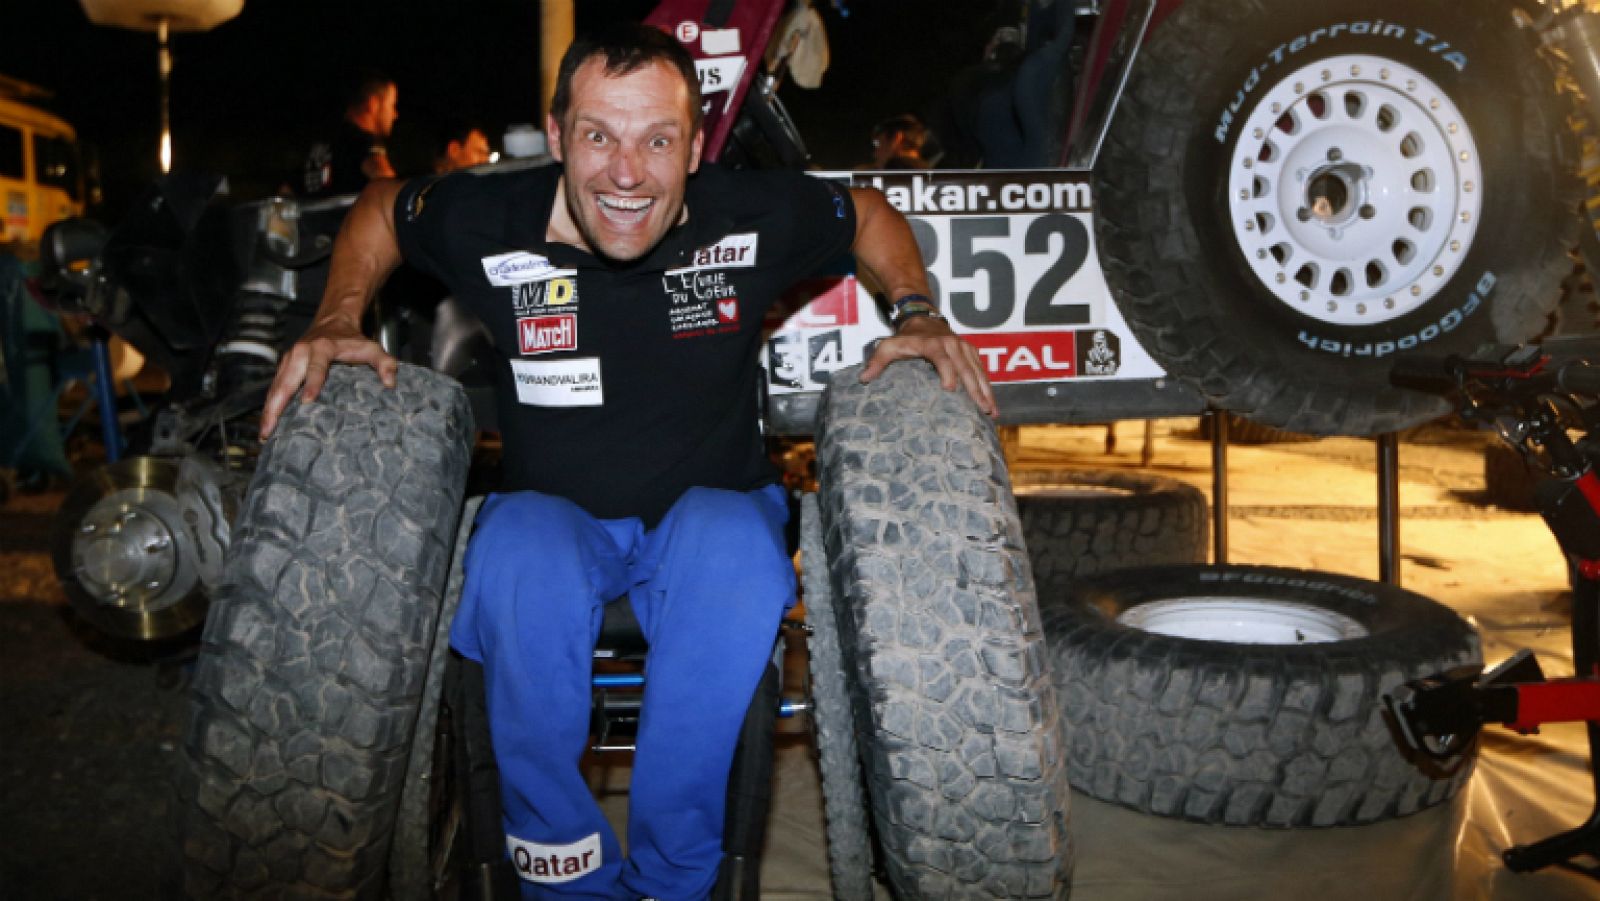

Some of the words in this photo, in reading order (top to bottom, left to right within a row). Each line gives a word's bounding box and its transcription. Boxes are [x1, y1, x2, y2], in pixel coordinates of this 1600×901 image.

[1214, 20, 1406, 144] Mud-Terrain
[1413, 28, 1468, 72] T/A
[690, 245, 751, 266] atar
[1297, 270, 1497, 358] BFGoodrich
[523, 319, 573, 350] MATCH
[978, 345, 1070, 372] TAL
[514, 846, 594, 877] Qatar
